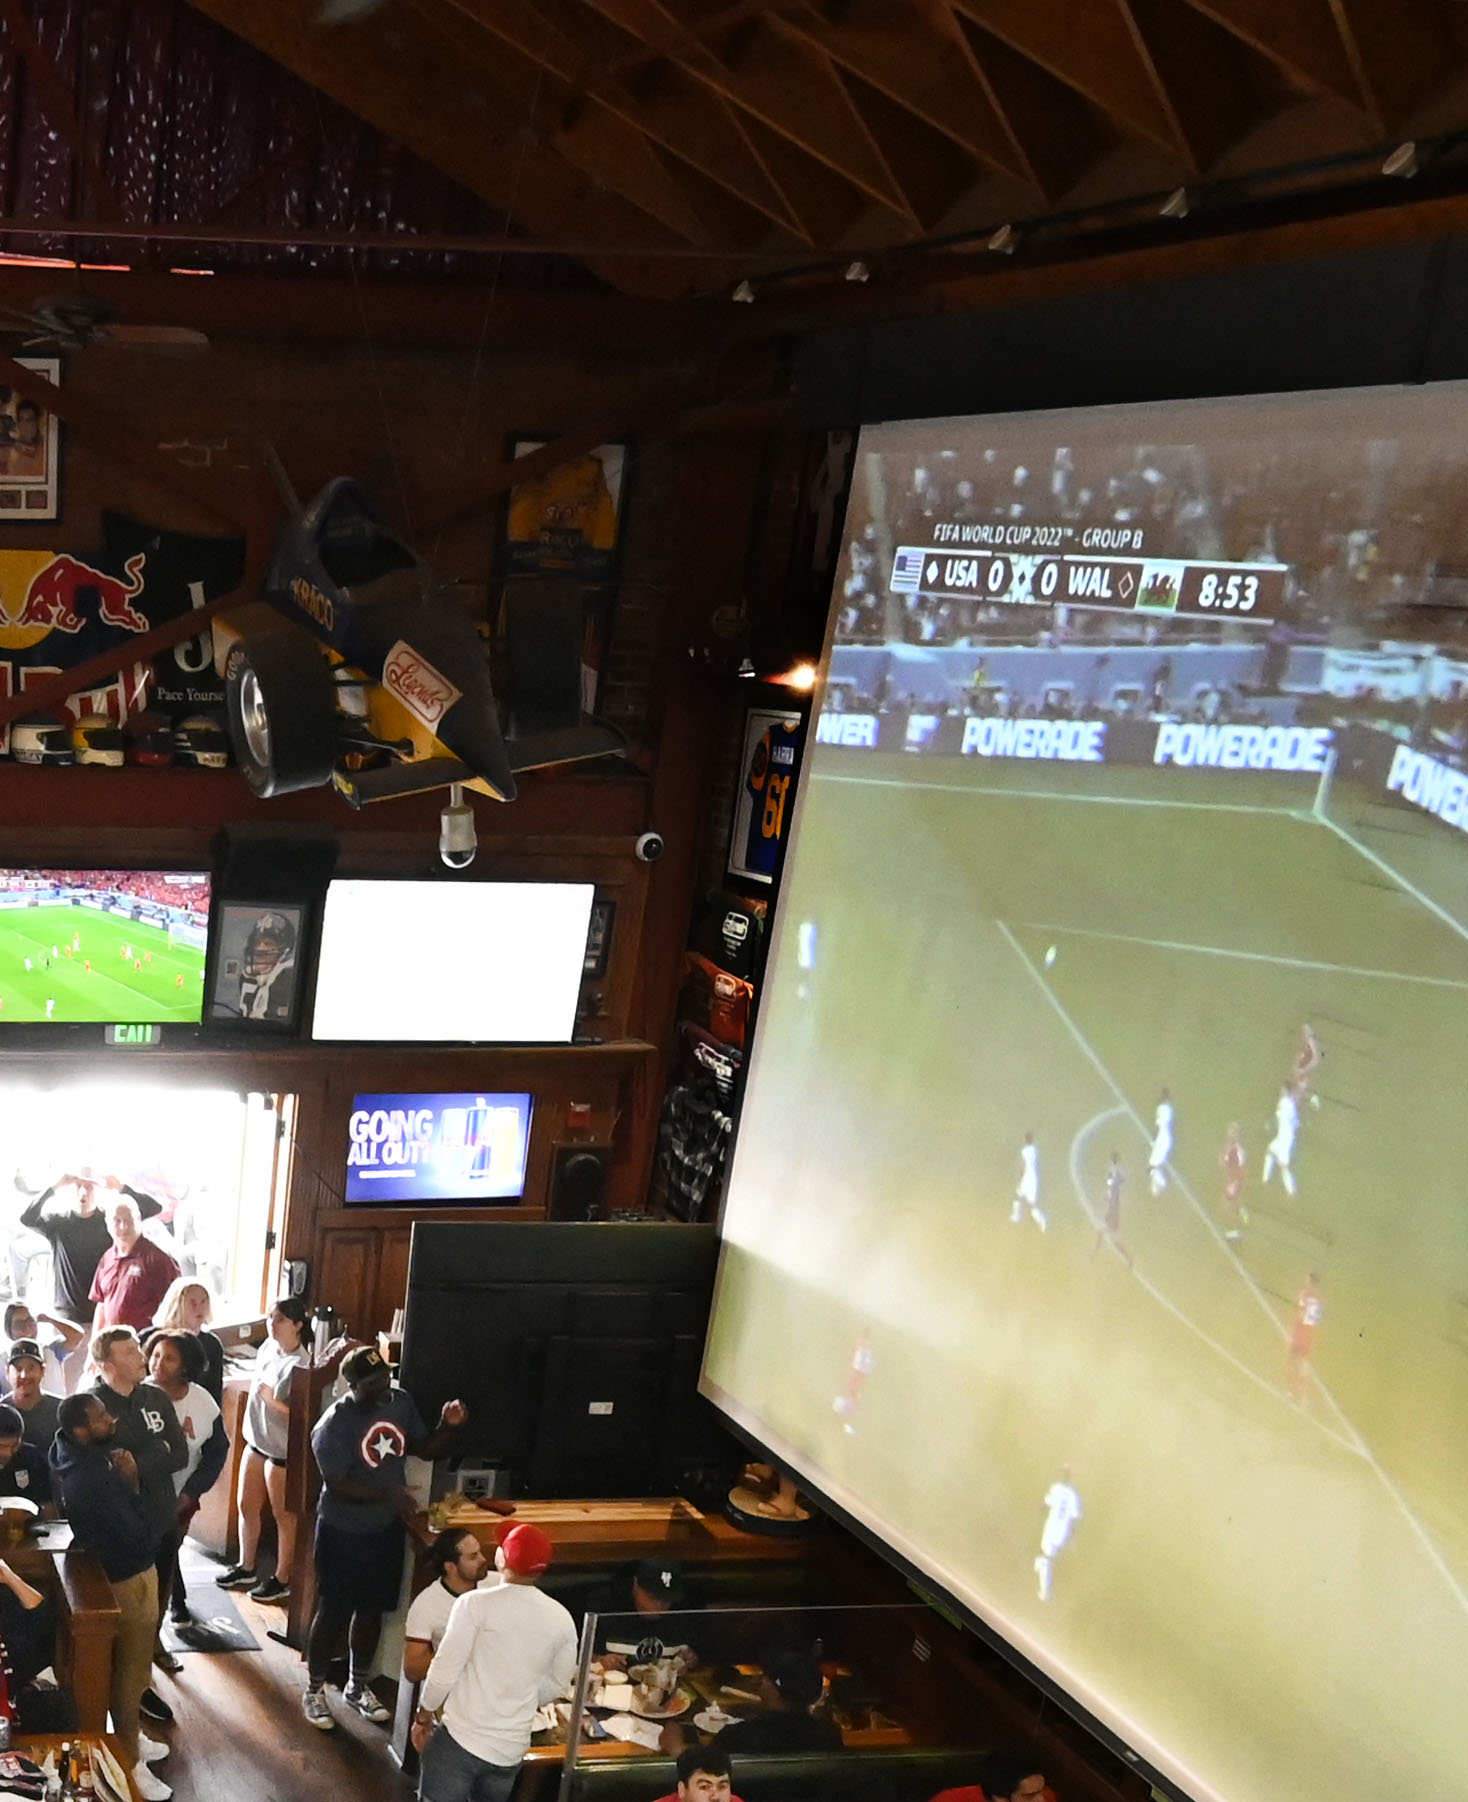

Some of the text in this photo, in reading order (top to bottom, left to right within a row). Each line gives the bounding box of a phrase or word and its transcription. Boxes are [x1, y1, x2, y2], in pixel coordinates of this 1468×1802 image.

[933, 523, 960, 542] FIFA
[960, 524, 1005, 545] WORLD
[1005, 526, 1031, 545] CUP
[1081, 527, 1131, 549] GROUP
[1131, 528, 1144, 550] B
[944, 559, 978, 589] USA
[987, 560, 1002, 593] 0
[1040, 563, 1058, 596] 0
[1067, 564, 1113, 600] WAL
[1198, 573, 1259, 611] 8:53
[156, 686, 186, 704] Pace
[961, 715, 1108, 763] POWERADE
[1153, 721, 1338, 774] POWERADE
[348, 1109, 434, 1143] GOING
[347, 1141, 380, 1166] ALL
